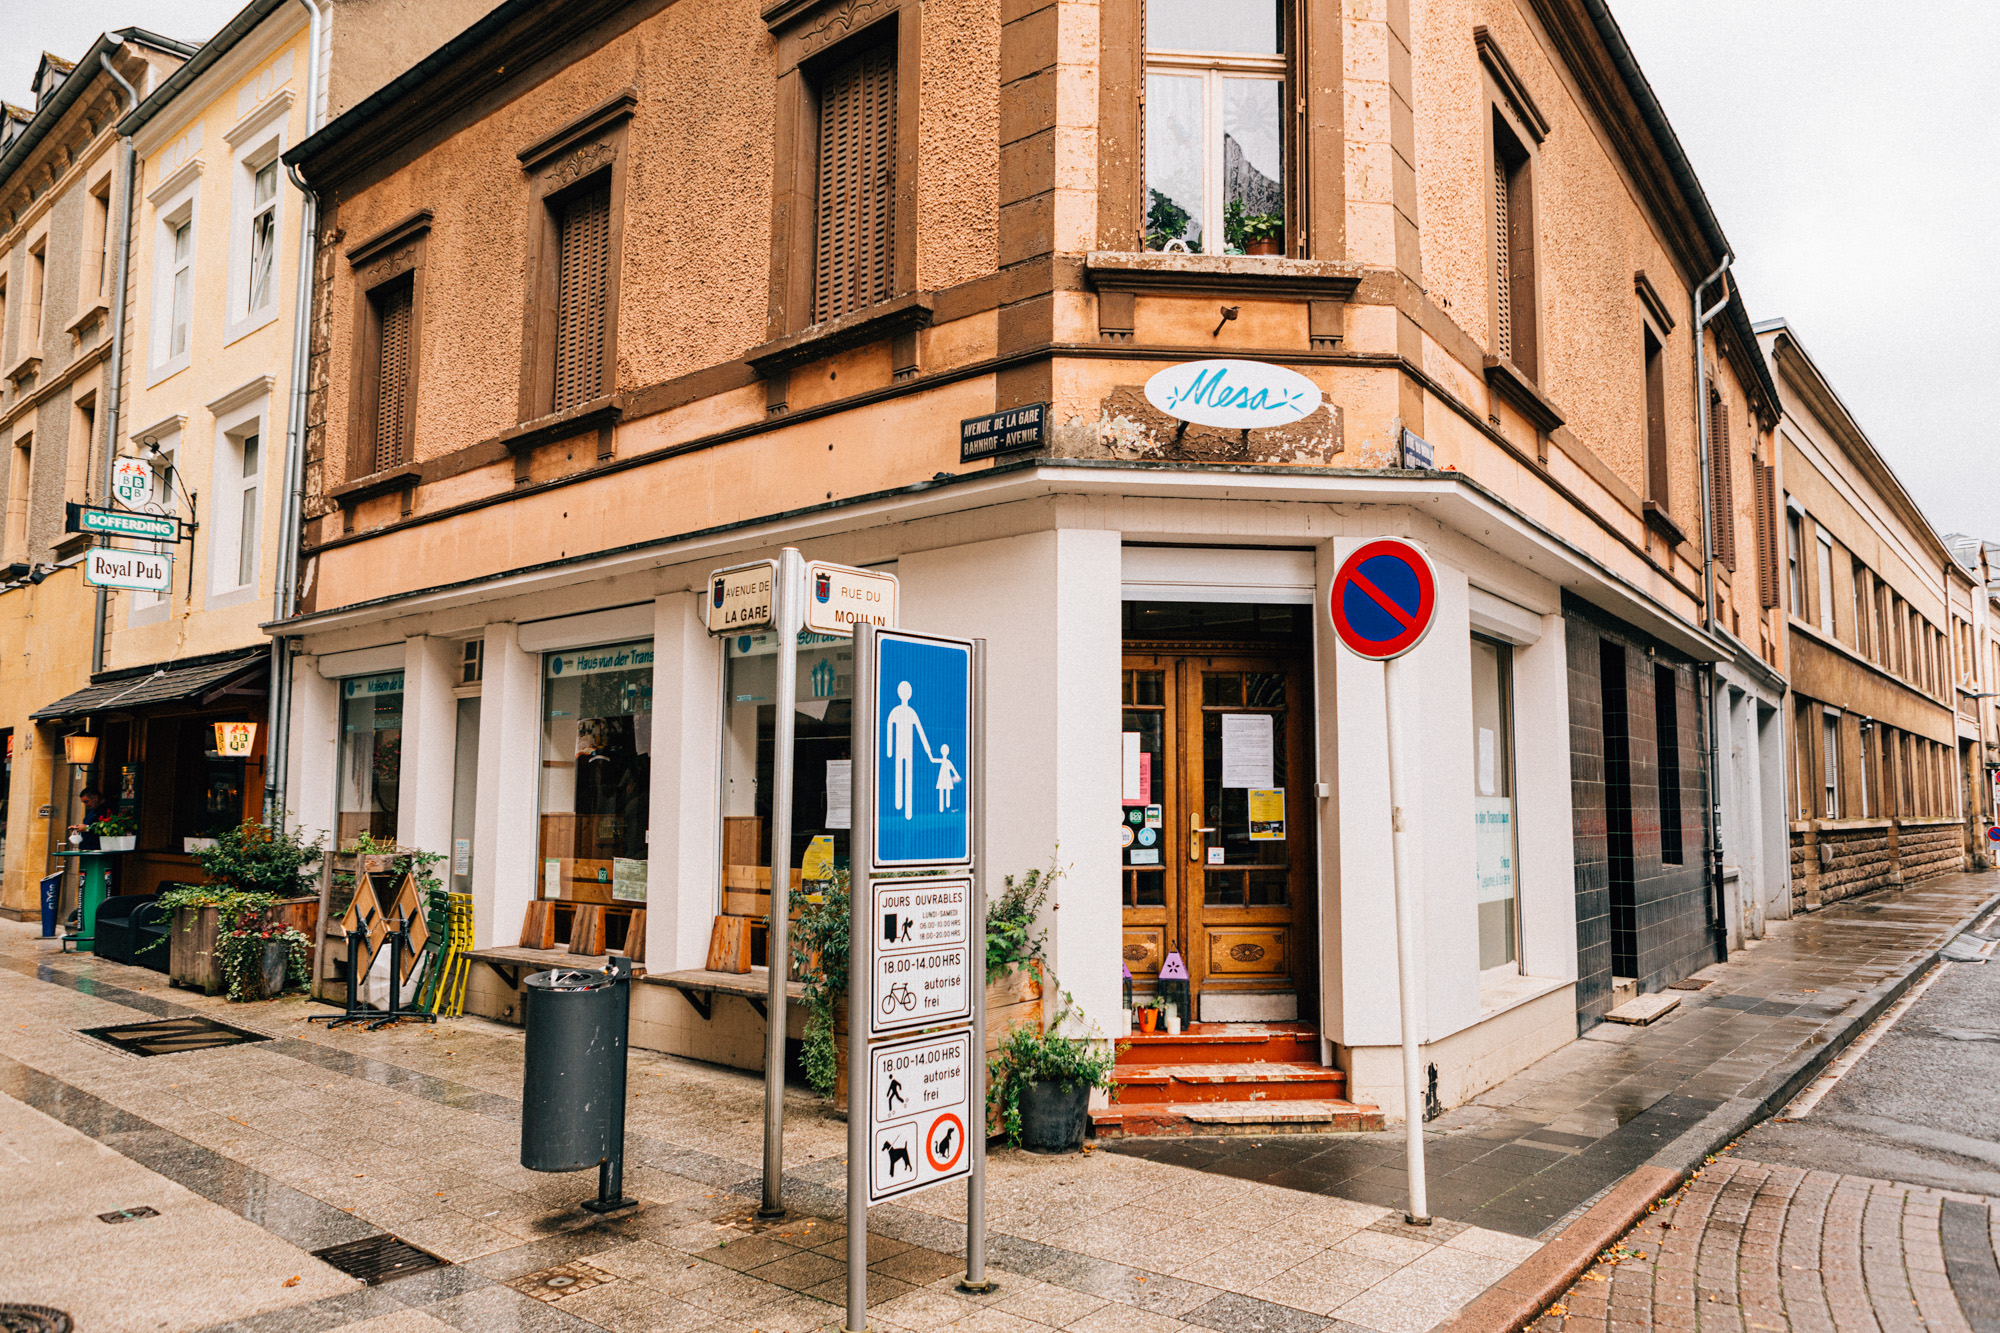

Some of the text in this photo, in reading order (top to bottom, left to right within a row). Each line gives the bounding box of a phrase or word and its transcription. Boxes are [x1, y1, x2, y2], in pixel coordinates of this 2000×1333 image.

[1179, 368, 1288, 410] Mesa
[964, 408, 1040, 438] AVENUE DE LA GARE
[964, 435, 998, 456] BAHNHOF
[1005, 427, 1038, 447] AVENUE
[88, 514, 171, 535] BOFFERDING
[95, 556, 162, 579] Royal Pub
[725, 580, 770, 599] AVENUE DE
[841, 586, 881, 602] RUE DU
[725, 605, 768, 624] LA GARE
[577, 656, 597, 671] Haus
[614, 652, 629, 667] der
[368, 679, 390, 692] Maison
[389, 677, 398, 690] de
[882, 892, 963, 908] JOURS OUVRABLES
[951, 919, 961, 927] HRS
[884, 953, 961, 974] 18.00-14.00 HRS
[924, 974, 961, 990] autorisé
[924, 994, 940, 1008] frei
[883, 1046, 960, 1073] 18.00-14.00 HRS
[923, 1065, 960, 1083] autorisé
[923, 1087, 939, 1102] frei
